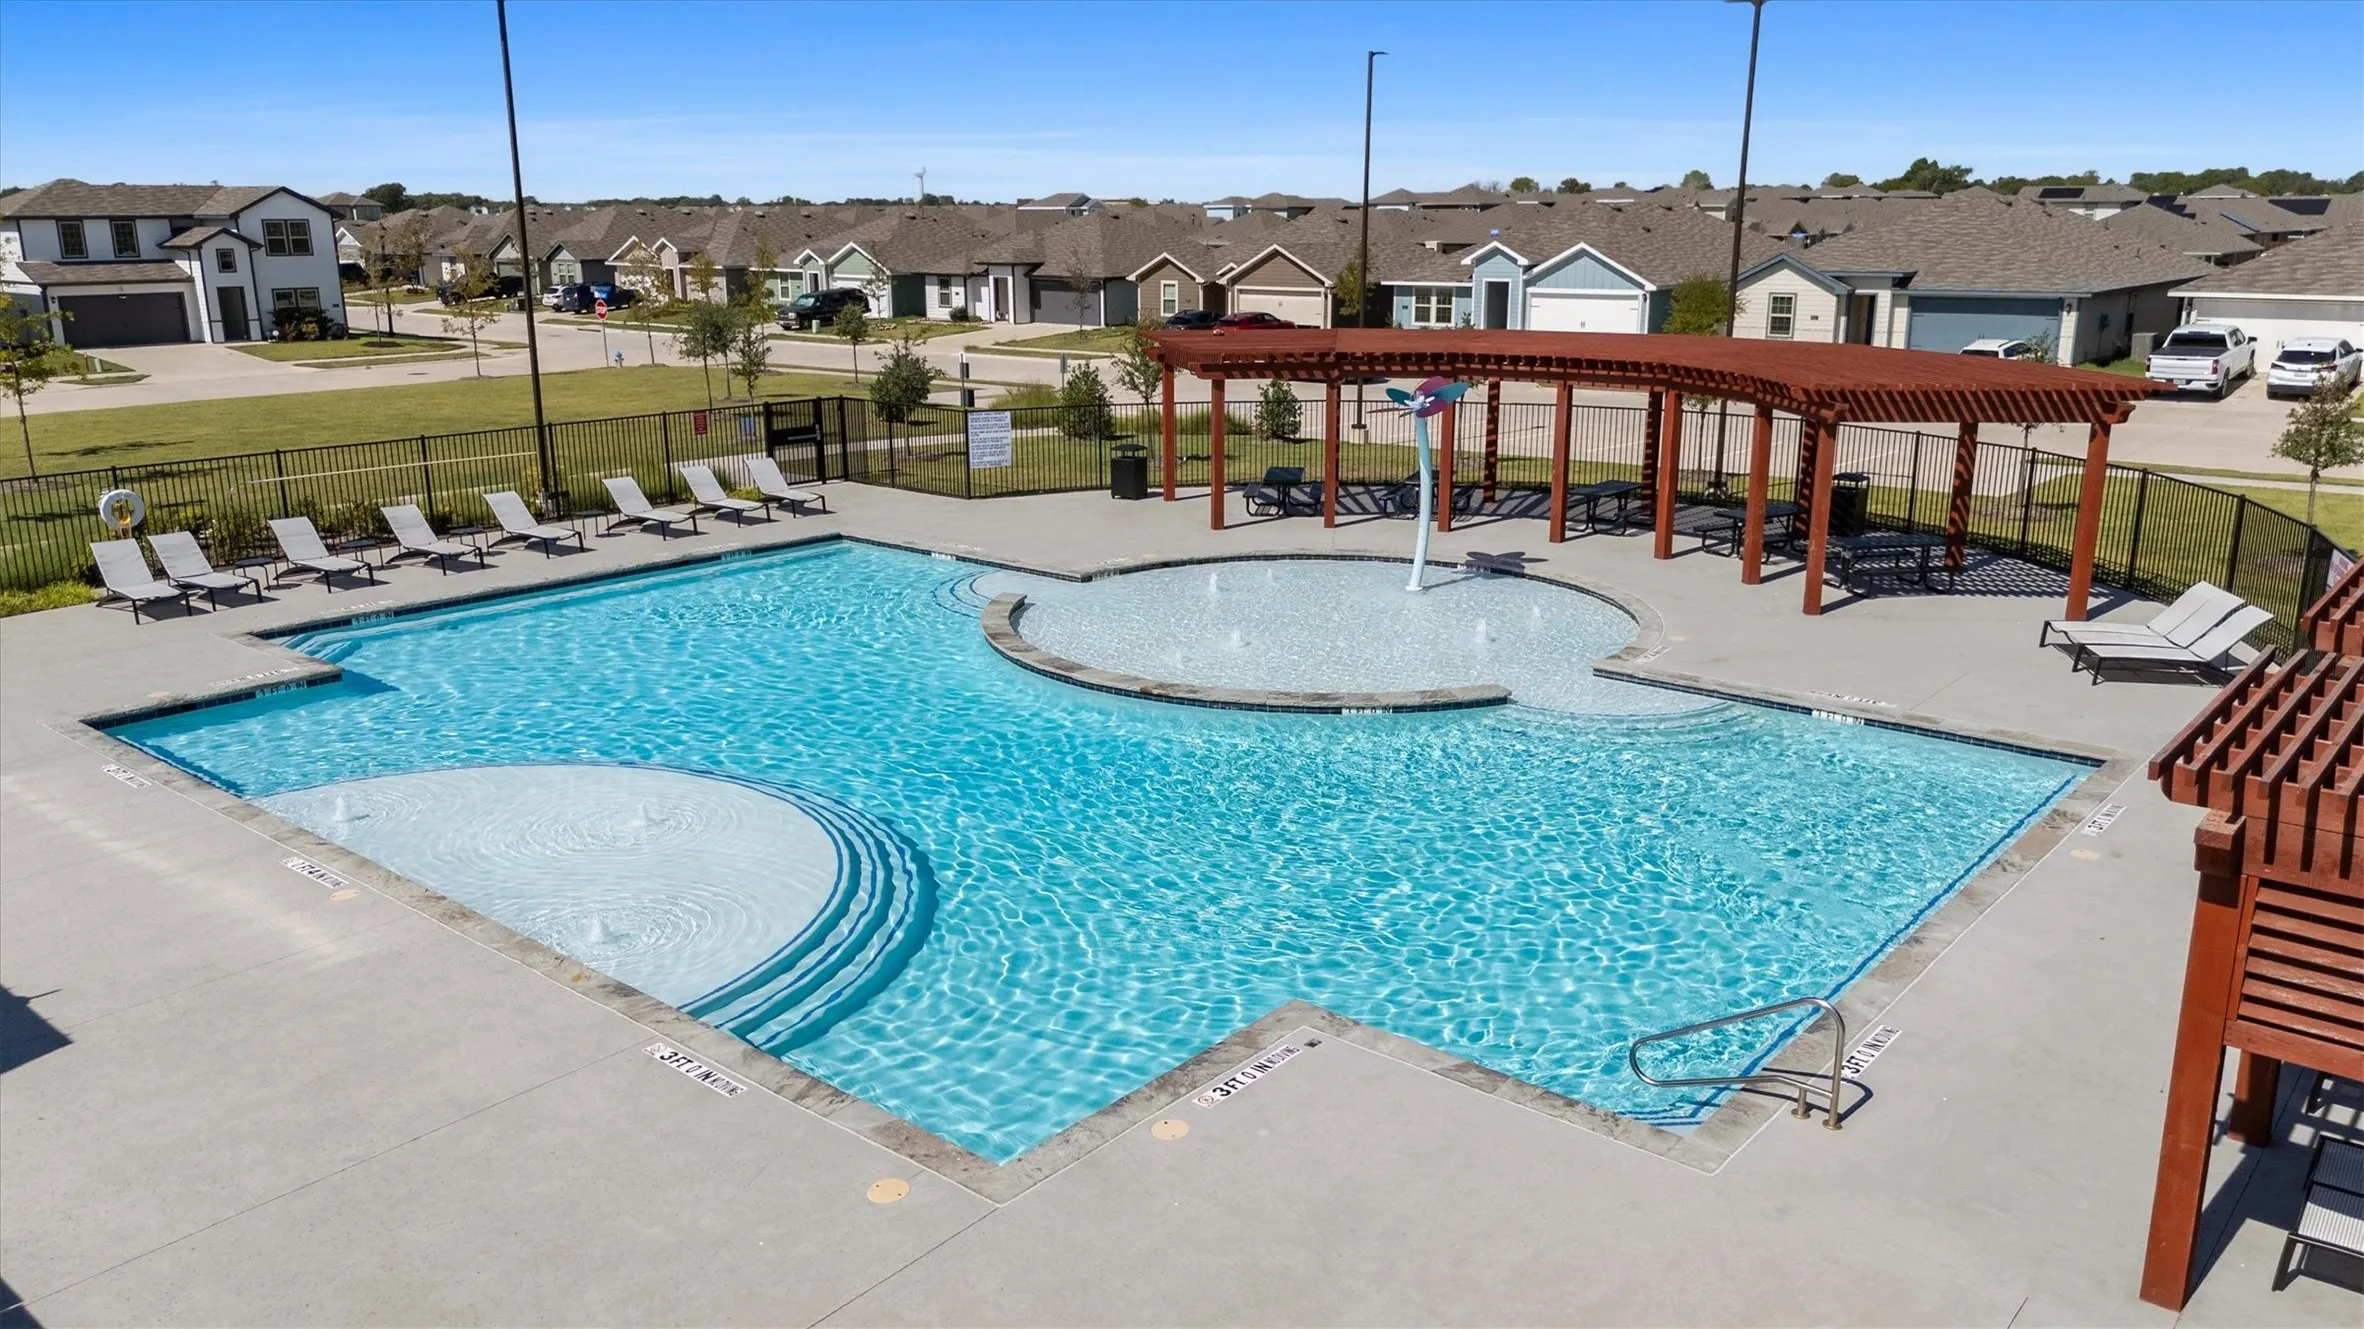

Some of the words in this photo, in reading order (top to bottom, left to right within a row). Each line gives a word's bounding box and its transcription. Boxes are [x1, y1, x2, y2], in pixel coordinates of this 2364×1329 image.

[1861, 1041, 1885, 1052] IN
[660, 1051, 679, 1061] 3
[668, 1056, 694, 1068] FT
[1846, 1055, 1869, 1068] FT
[694, 1069, 718, 1082] IN
[1841, 1065, 1861, 1074] 3
[1212, 1086, 1232, 1097] 3
[1250, 1061, 1273, 1074] IN
